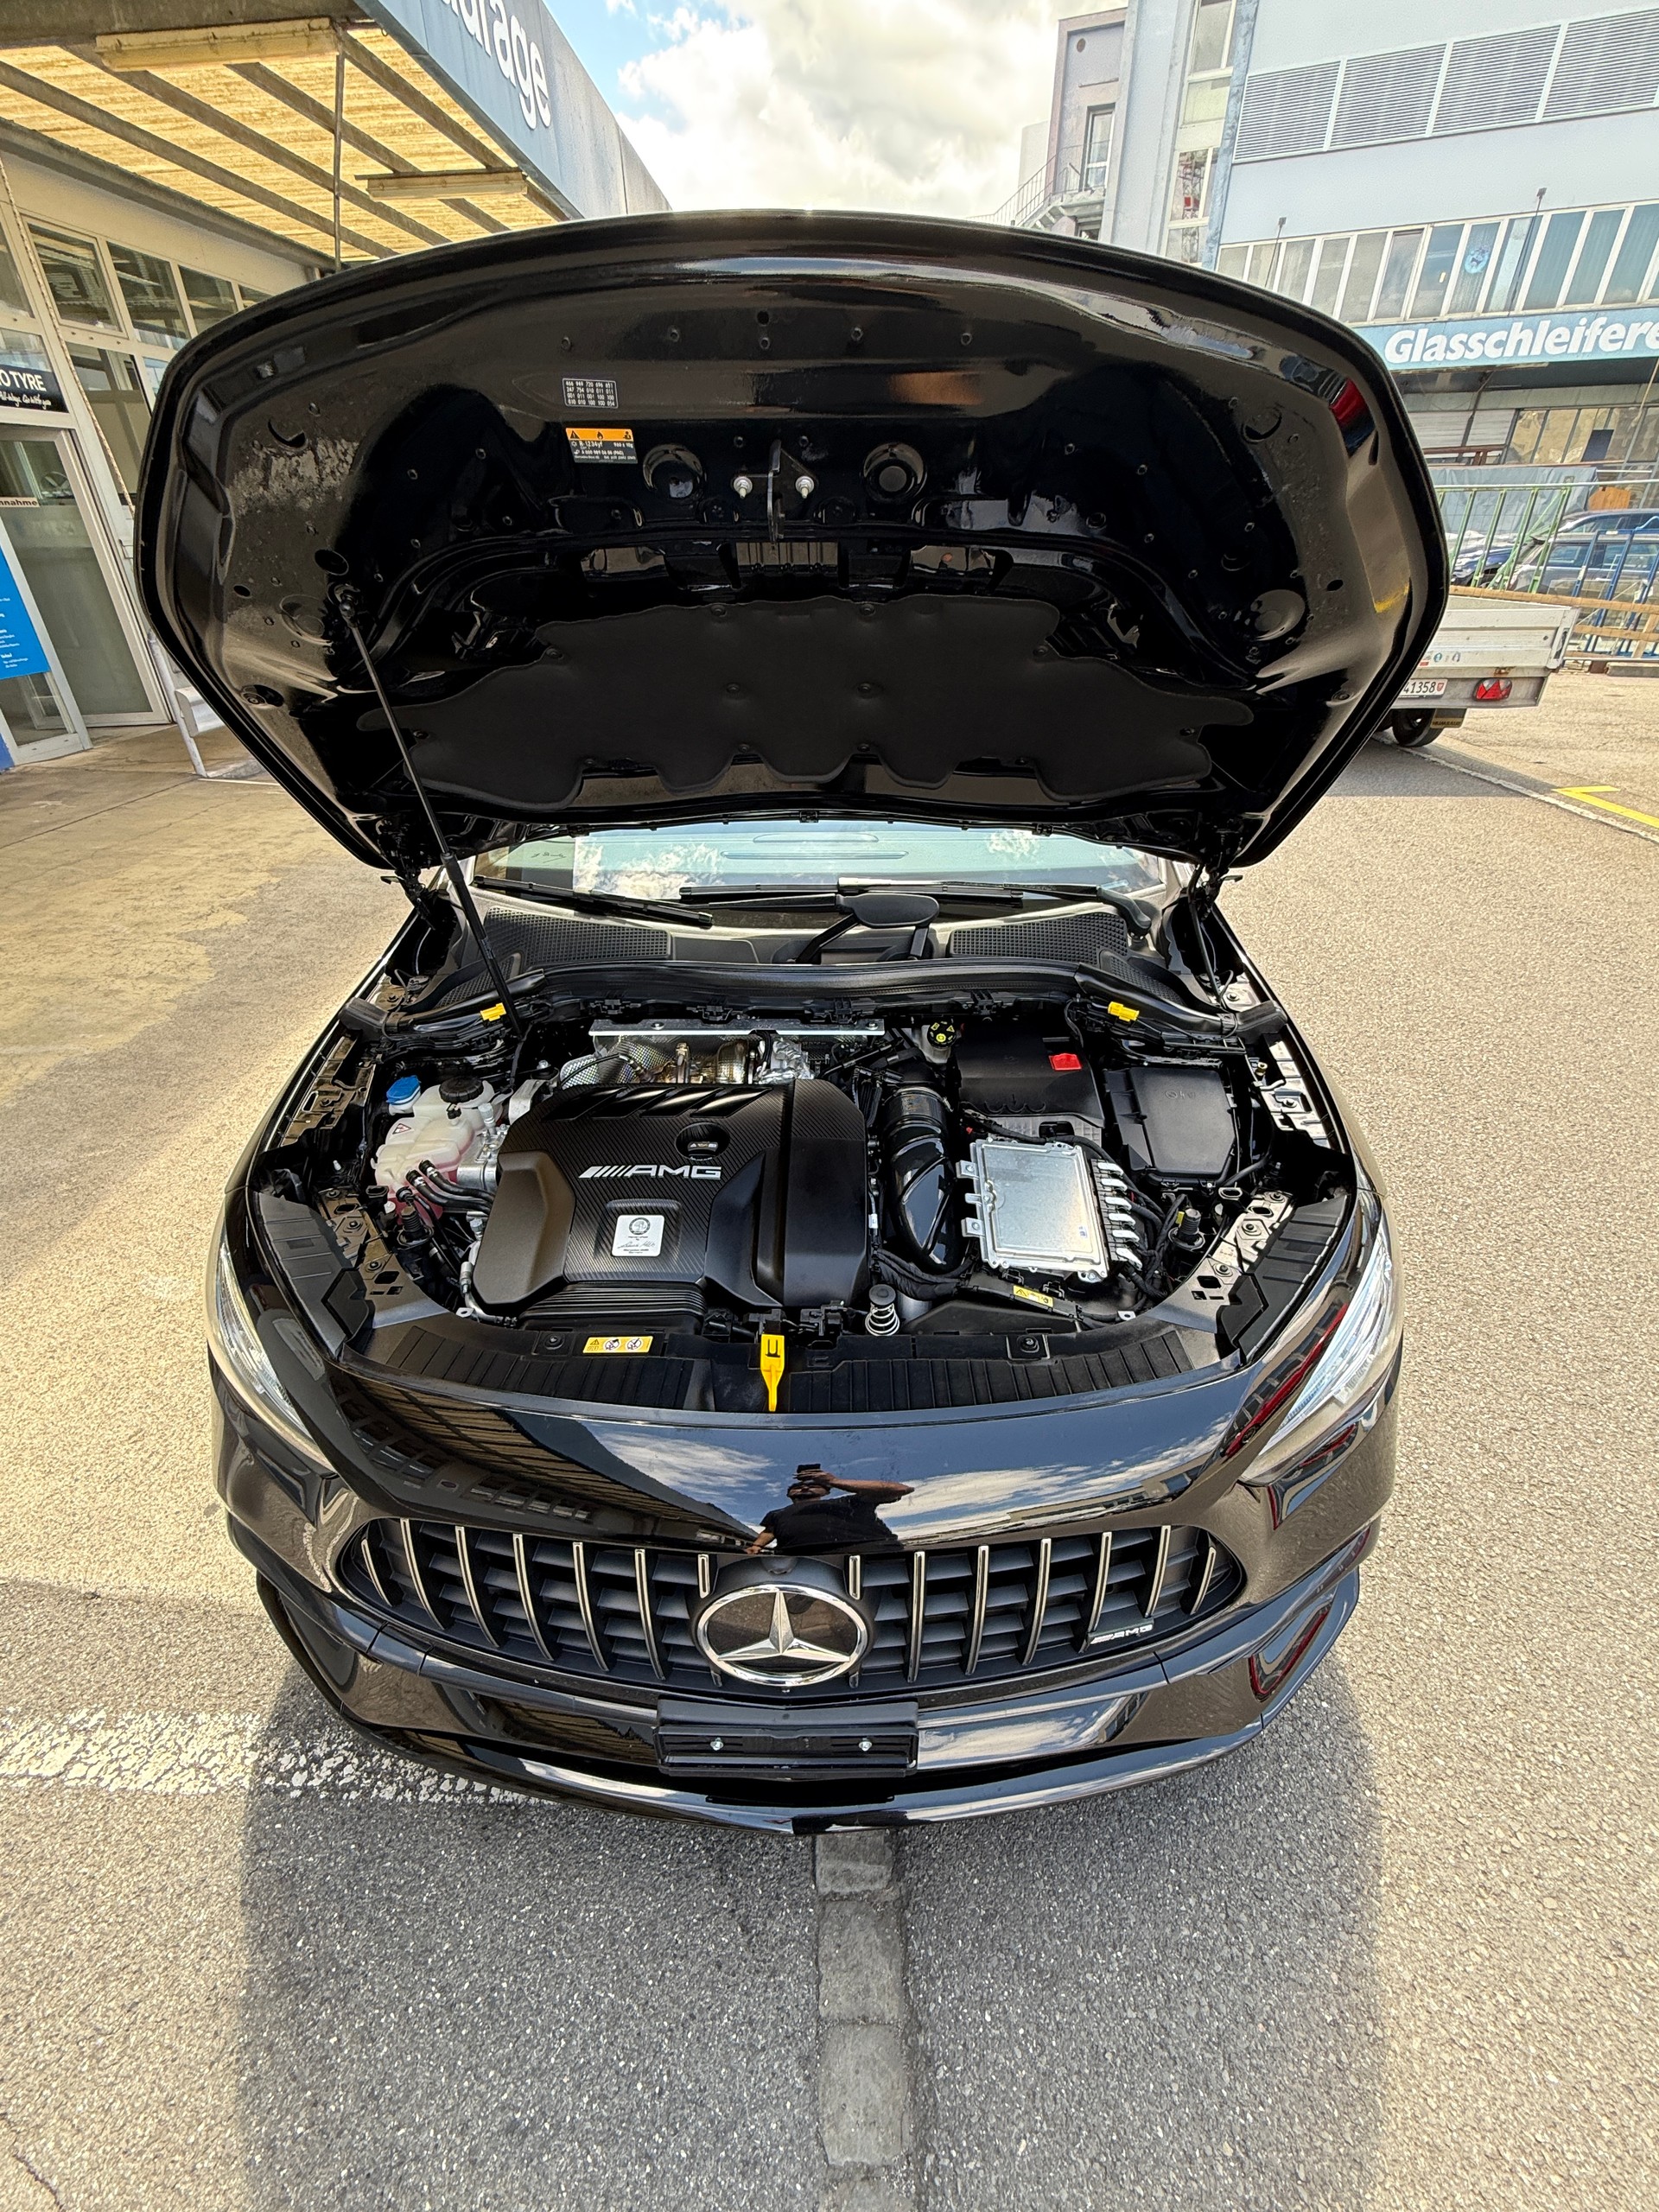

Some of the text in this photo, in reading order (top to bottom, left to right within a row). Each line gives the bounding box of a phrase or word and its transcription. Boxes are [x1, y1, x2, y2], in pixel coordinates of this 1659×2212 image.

[442, 0, 551, 130] arage
[0, 369, 47, 391] OTYRE
[626, 1165, 721, 1179] AMG
